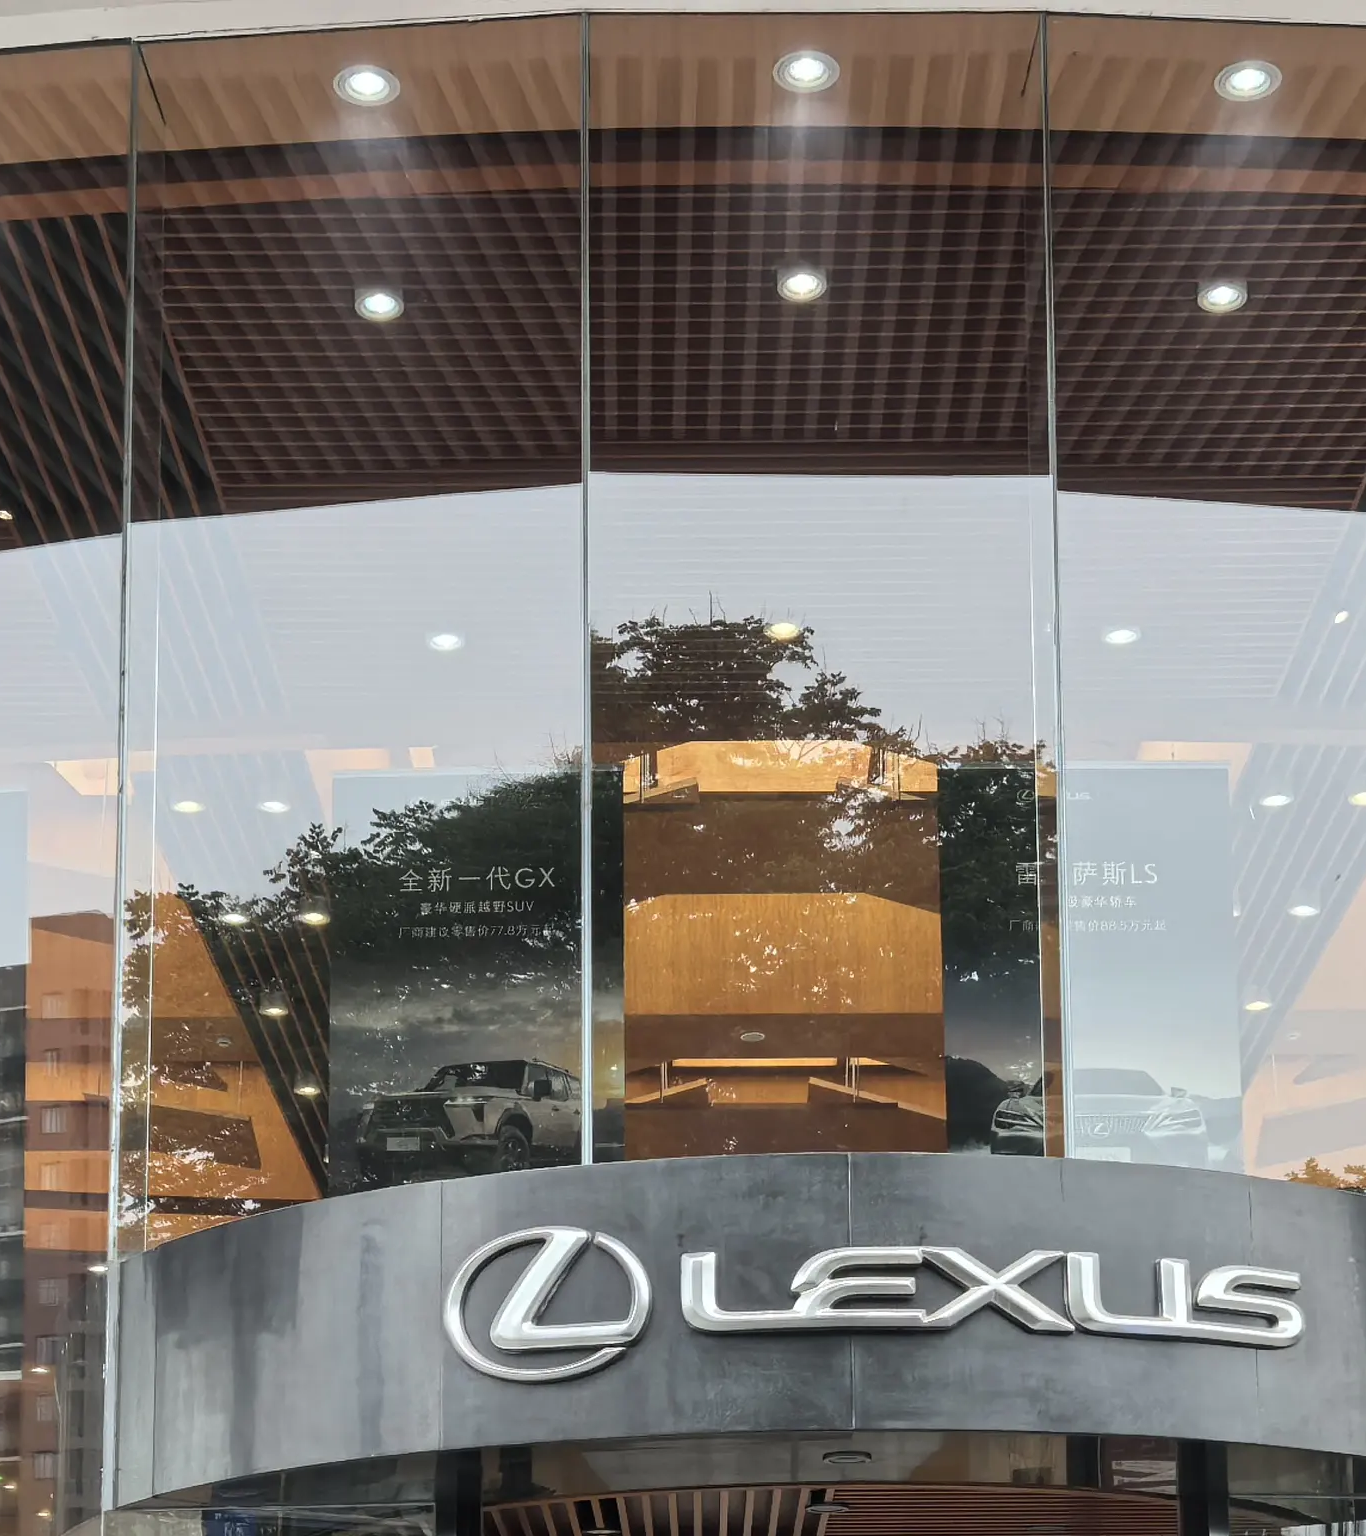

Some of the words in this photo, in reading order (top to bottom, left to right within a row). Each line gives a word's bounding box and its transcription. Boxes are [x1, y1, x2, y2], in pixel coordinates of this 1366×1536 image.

[398, 866, 555, 892] 全新一代GX
[1015, 861, 1158, 886] 雷萨斯LS
[680, 1246, 1303, 1349] LEXUS
